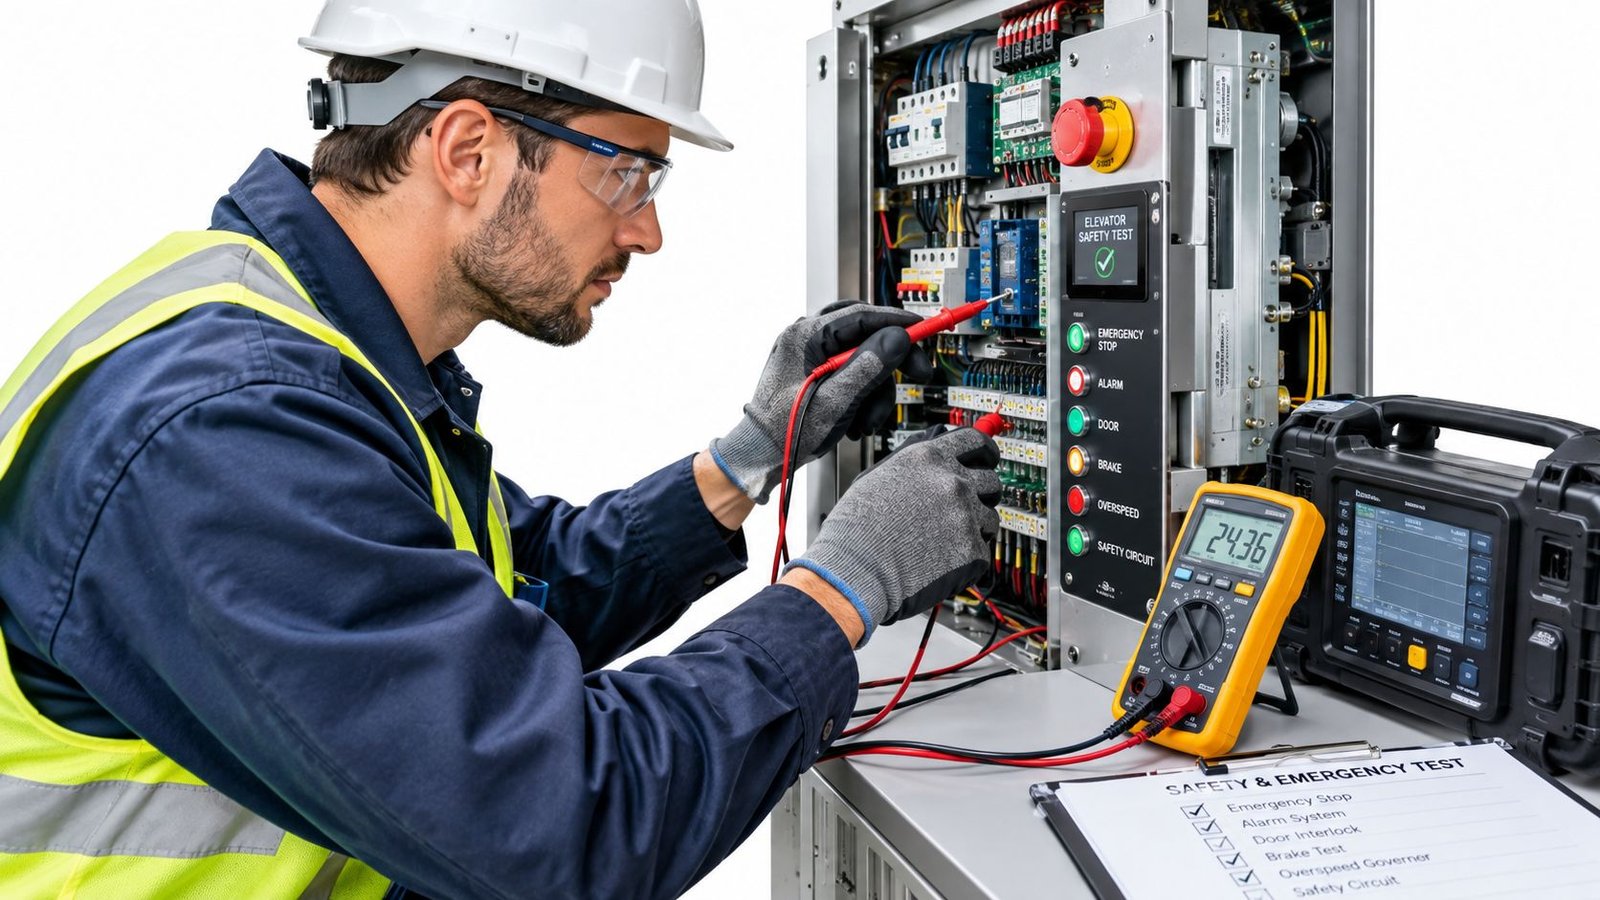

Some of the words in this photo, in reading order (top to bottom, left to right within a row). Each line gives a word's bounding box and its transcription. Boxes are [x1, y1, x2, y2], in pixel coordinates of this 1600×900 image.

[1084, 214, 1126, 228] ELEVATOR
[1078, 230, 1110, 243] SAFETY
[1111, 228, 1134, 240] TEST
[1098, 328, 1144, 340] EMERGENCY
[1098, 341, 1117, 351] STOP
[1098, 379, 1124, 390] ALARM
[1098, 419, 1119, 432] DOOR
[1098, 459, 1122, 474] BRAKE
[1097, 500, 1139, 519] OVERSPEED
[1206, 522, 1273, 564] 24.36
[1097, 541, 1125, 558] SAFETY
[1125, 550, 1155, 567] CIRCUIT
[1165, 778, 1248, 797] SAFETY
[1255, 776, 1273, 788] &
[1277, 763, 1406, 787] EMERGENCY
[1411, 758, 1466, 773] TEST
[1227, 796, 1313, 815] Emergency
[1317, 791, 1353, 804] Stop
[1242, 816, 1287, 830] Alarm
[1292, 809, 1347, 825] System
[1252, 832, 1290, 846] Door
[1296, 824, 1362, 841] Interlock
[1265, 848, 1310, 863] Brake
[1314, 843, 1347, 856] Test
[1279, 860, 1360, 880] Overspeed
[1363, 852, 1432, 869] Governor
[1293, 883, 1344, 898] Safety
[1348, 875, 1401, 890] Circuit
